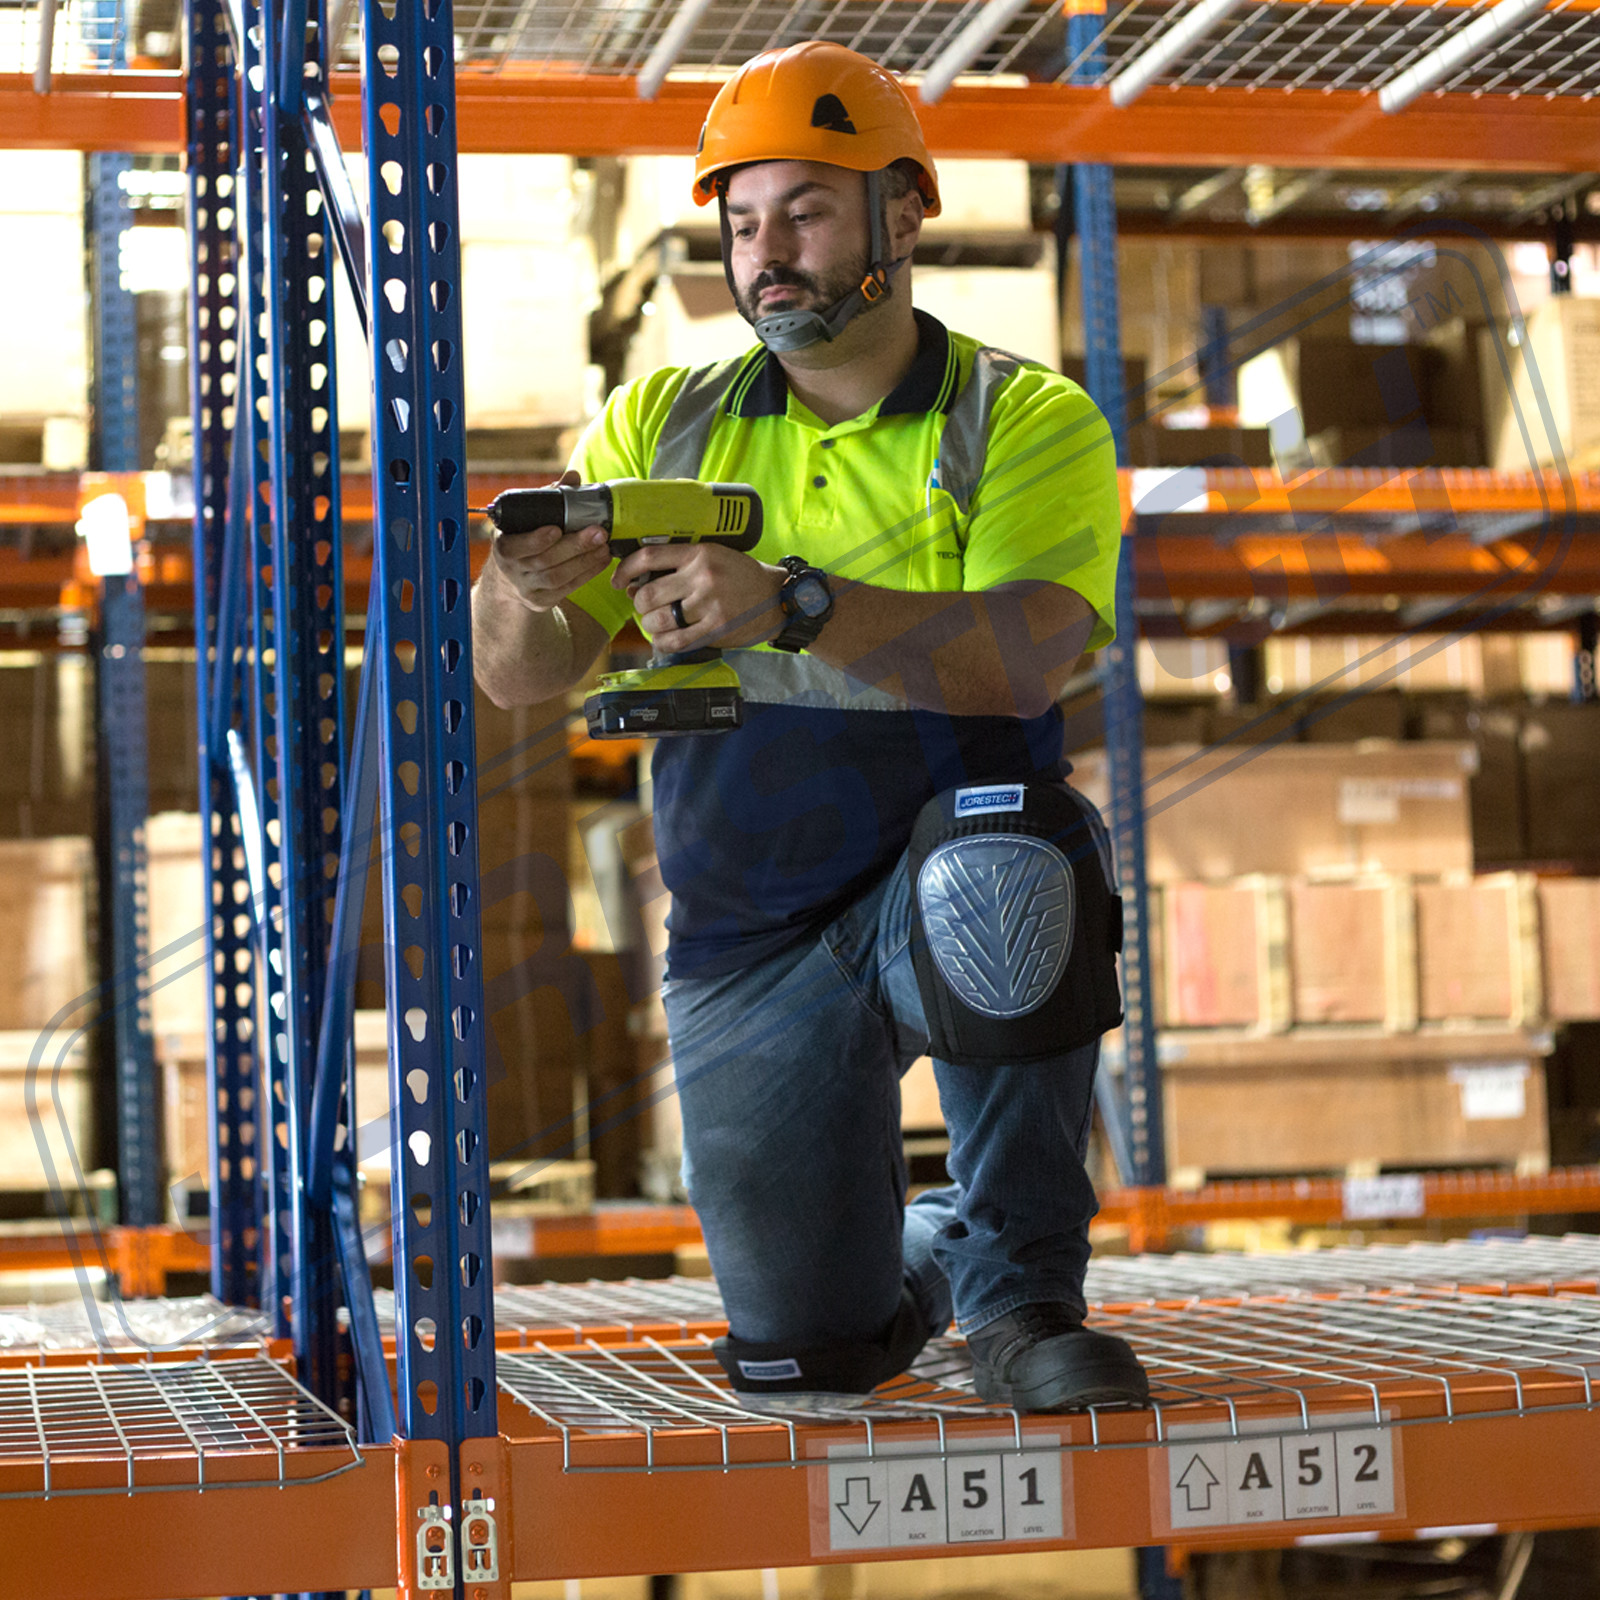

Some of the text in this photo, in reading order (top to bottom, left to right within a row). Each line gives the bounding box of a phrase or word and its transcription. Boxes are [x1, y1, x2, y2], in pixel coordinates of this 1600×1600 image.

[1239, 1444, 1379, 1490] A 5 2
[901, 1467, 1045, 1512] A 5 1
[1246, 1502, 1378, 1518] RACK LOCATION LEVEL
[908, 1526, 1045, 1540] RACK LOCATION LEVEL
